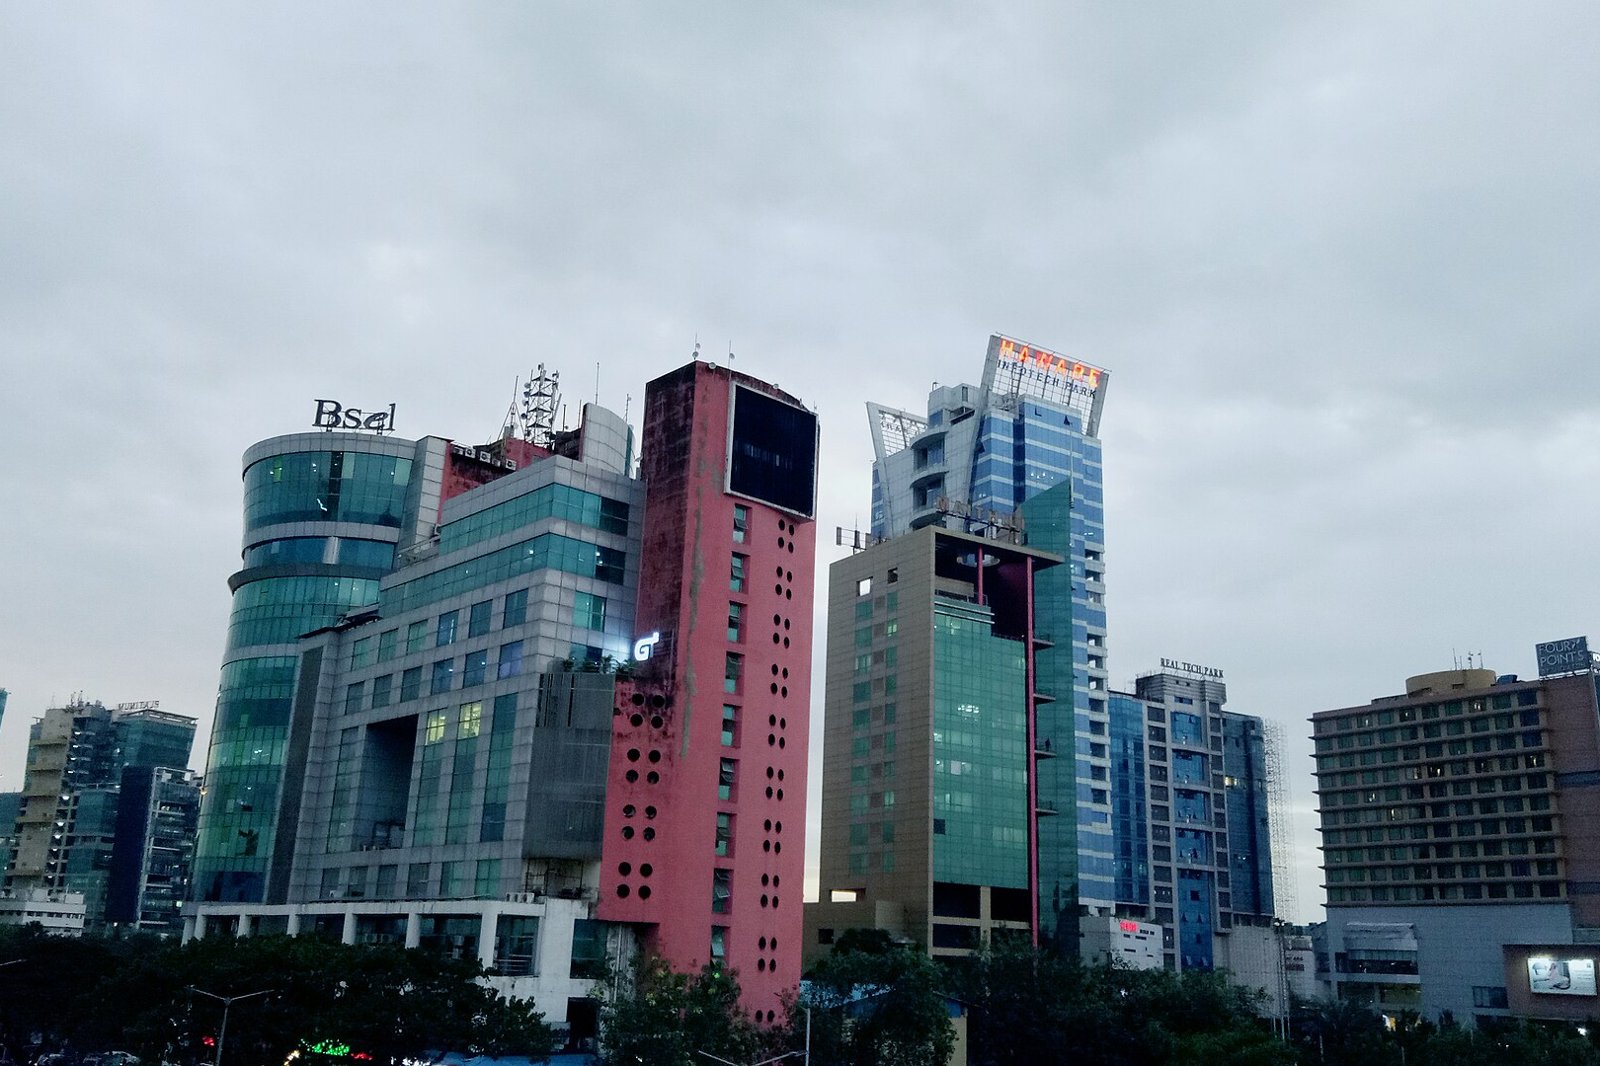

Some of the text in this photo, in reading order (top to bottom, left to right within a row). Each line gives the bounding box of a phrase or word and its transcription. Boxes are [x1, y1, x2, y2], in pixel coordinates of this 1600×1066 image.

[998, 338, 1102, 389] HAWARE
[997, 360, 1098, 400] INFOTECH PARK
[1160, 658, 1224, 679] REAL TECH PARK
[1540, 650, 1584, 666] POINTS
